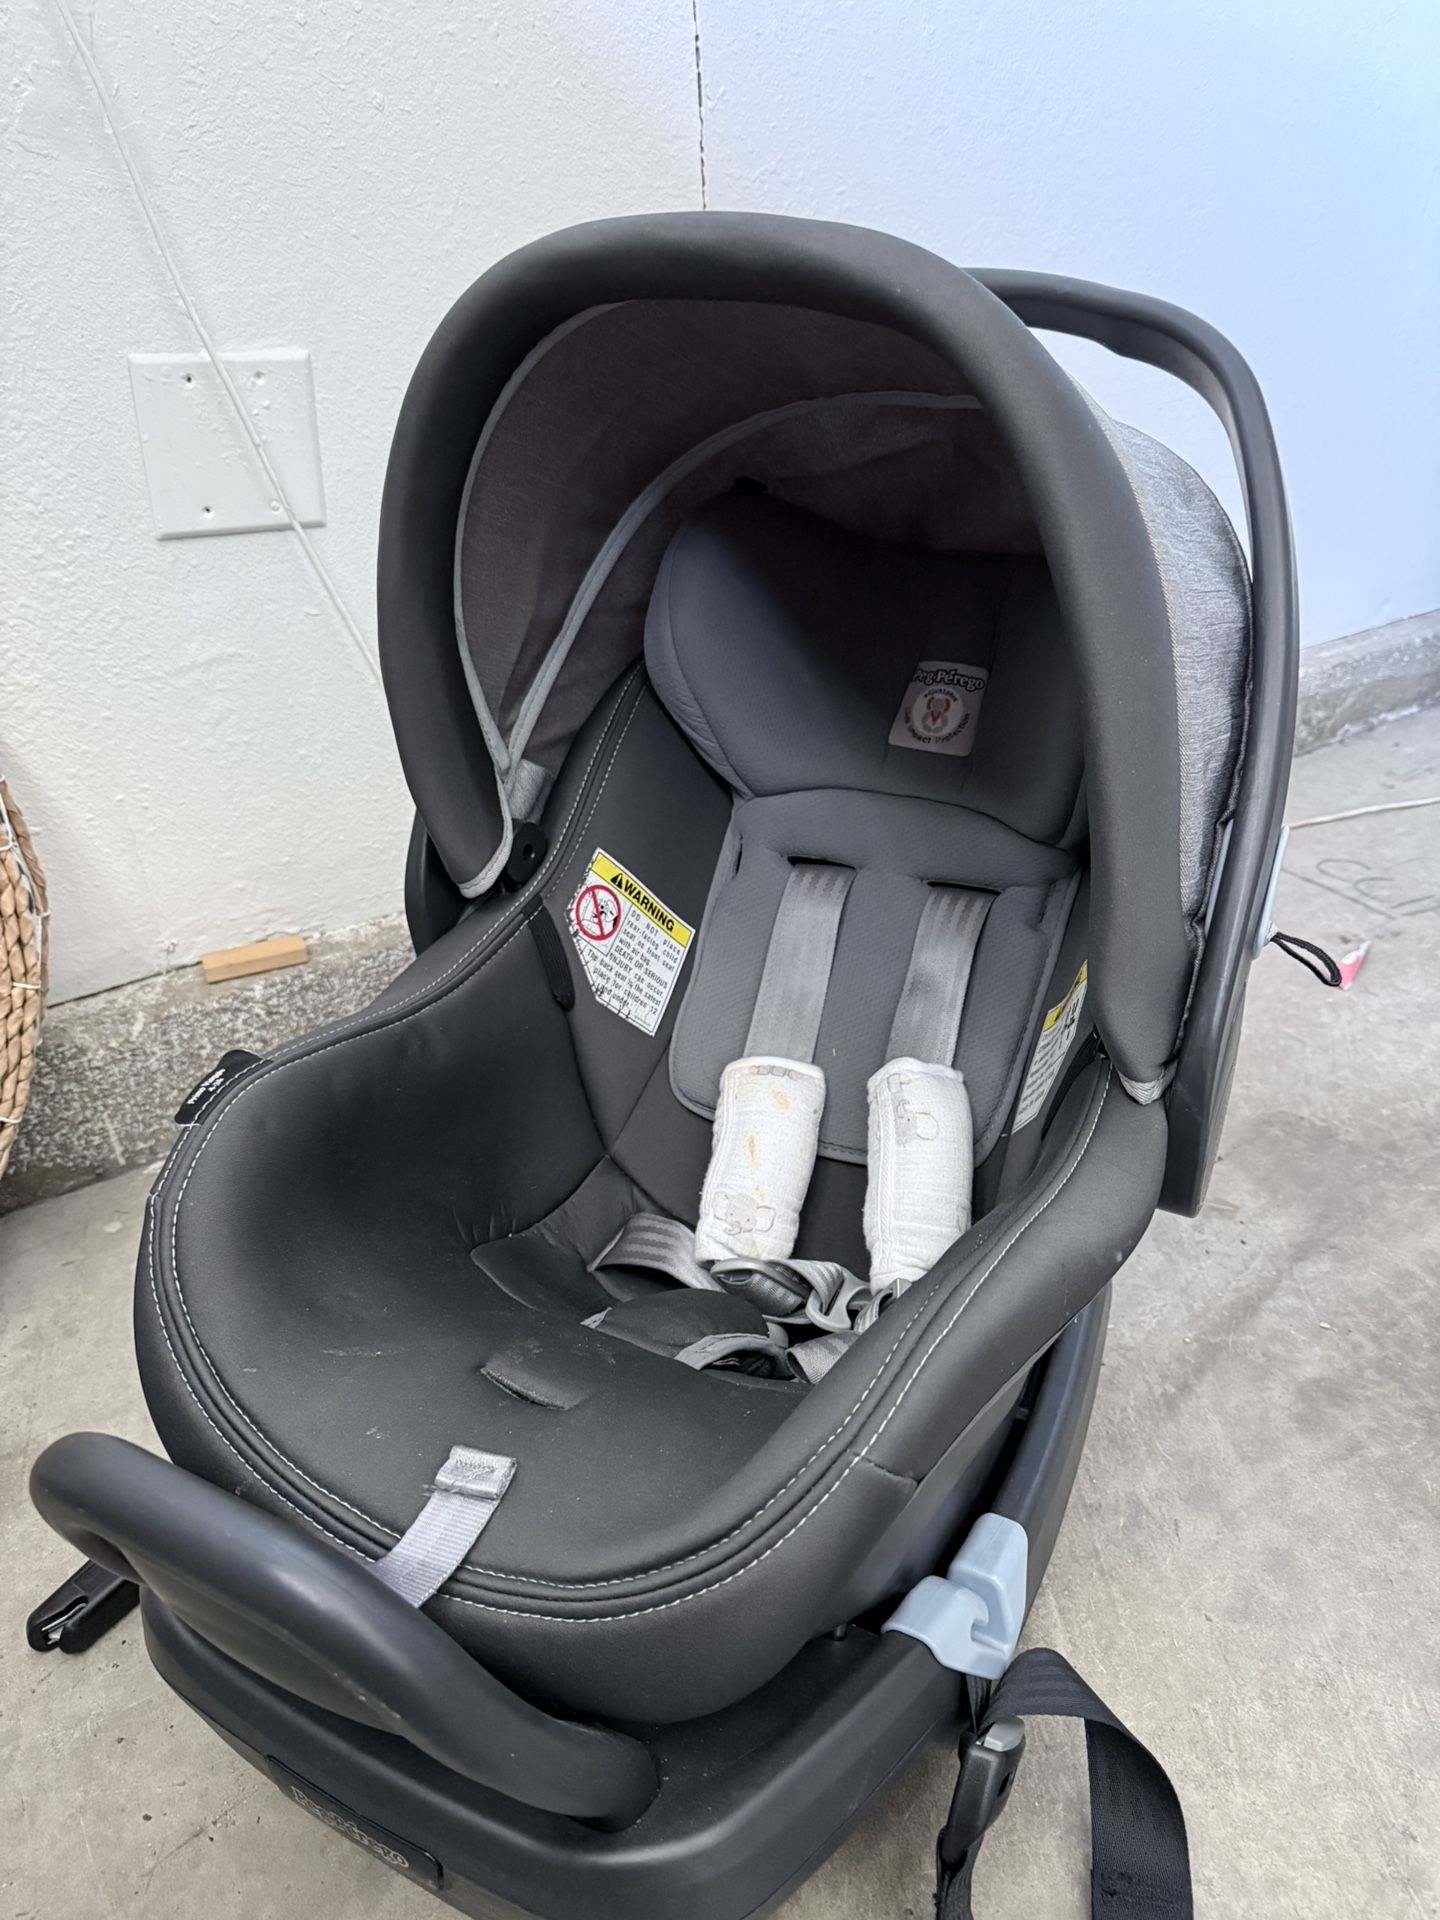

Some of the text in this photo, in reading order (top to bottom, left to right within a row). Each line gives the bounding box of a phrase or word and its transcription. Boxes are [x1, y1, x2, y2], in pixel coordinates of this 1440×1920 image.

[624, 879, 675, 932] WARNING
[619, 938, 631, 951] with
[632, 948, 640, 956] air
[623, 929, 636, 943] seat
[647, 947, 660, 962] front
[662, 959, 675, 973] seat
[626, 920, 678, 964] rear-facing child
[631, 910, 680, 955] DO NOT place
[587, 948, 598, 961] The
[599, 958, 614, 972] back
[614, 970, 627, 982] seat
[634, 984, 643, 994] the
[644, 992, 662, 1008] safest
[609, 953, 633, 973] INJURY
[634, 973, 645, 984] can
[614, 945, 668, 989] DEATH OR SERIOUS
[593, 967, 658, 1016] place for children 12
